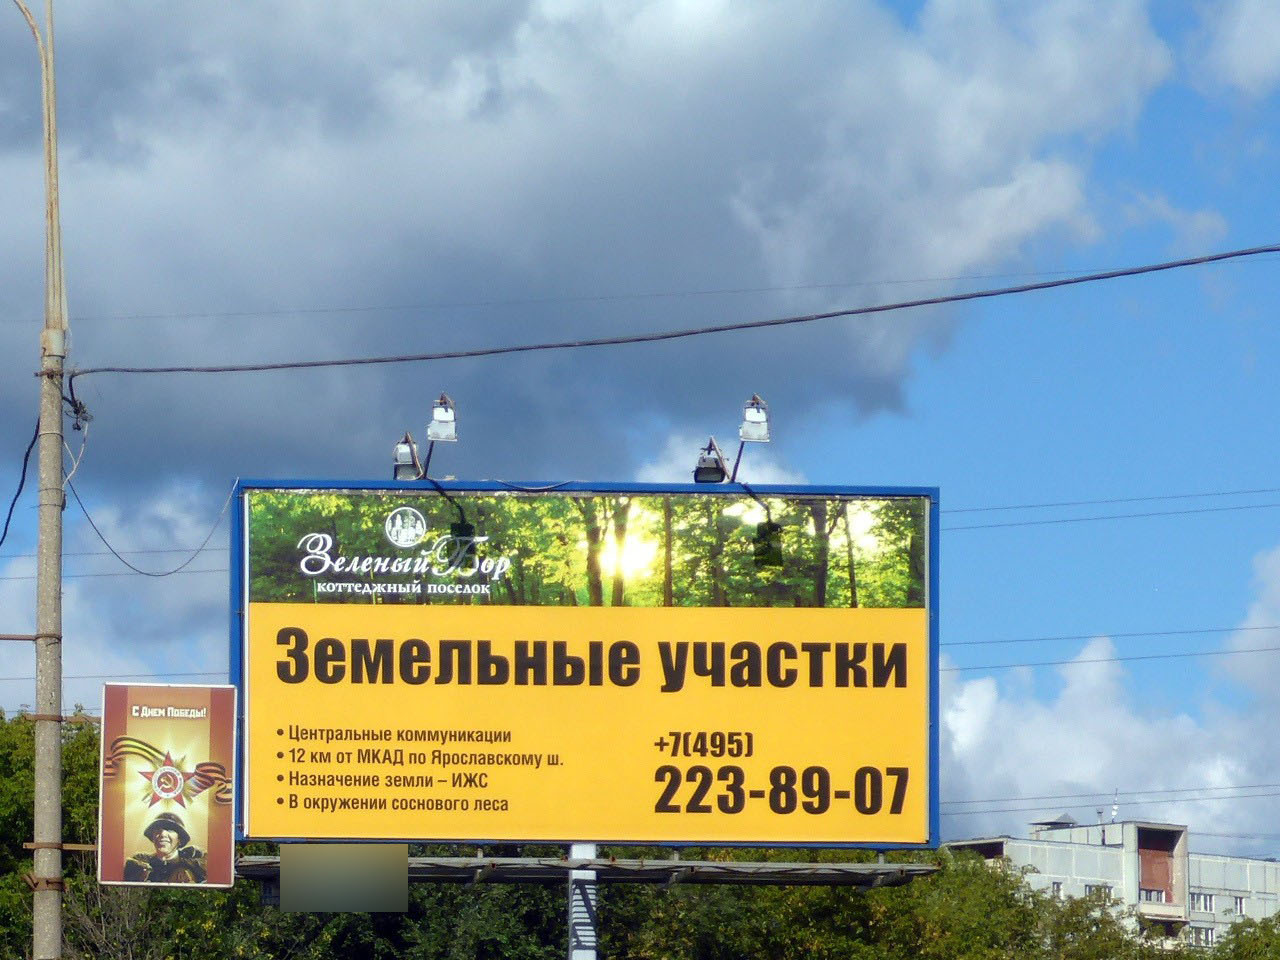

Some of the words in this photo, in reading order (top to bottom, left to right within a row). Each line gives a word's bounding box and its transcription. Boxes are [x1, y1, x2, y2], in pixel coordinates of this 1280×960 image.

[296, 532, 429, 575] Зеленый
[420, 534, 512, 580] Бор
[317, 580, 422, 595] коттеджный
[427, 582, 490, 594] поселок
[276, 626, 641, 687] Земельные
[657, 641, 908, 693] участки
[289, 725, 392, 743] Центральные
[397, 729, 512, 744] коммуникации
[654, 731, 754, 758] +7(495)
[289, 748, 306, 763] 12
[310, 751, 331, 764] км
[336, 751, 353, 764] от
[357, 749, 404, 766] МКАД
[409, 752, 427, 765] по
[431, 750, 543, 768] Ярославскому
[547, 753, 564, 766] ш.
[289, 771, 380, 786] Назначение
[385, 774, 433, 788] земли
[452, 772, 489, 788] ИЖС
[654, 764, 910, 816] 223-89-07
[289, 794, 299, 809] В
[303, 796, 387, 812] окружении
[391, 797, 470, 812] соснового
[474, 798, 509, 812] леса
